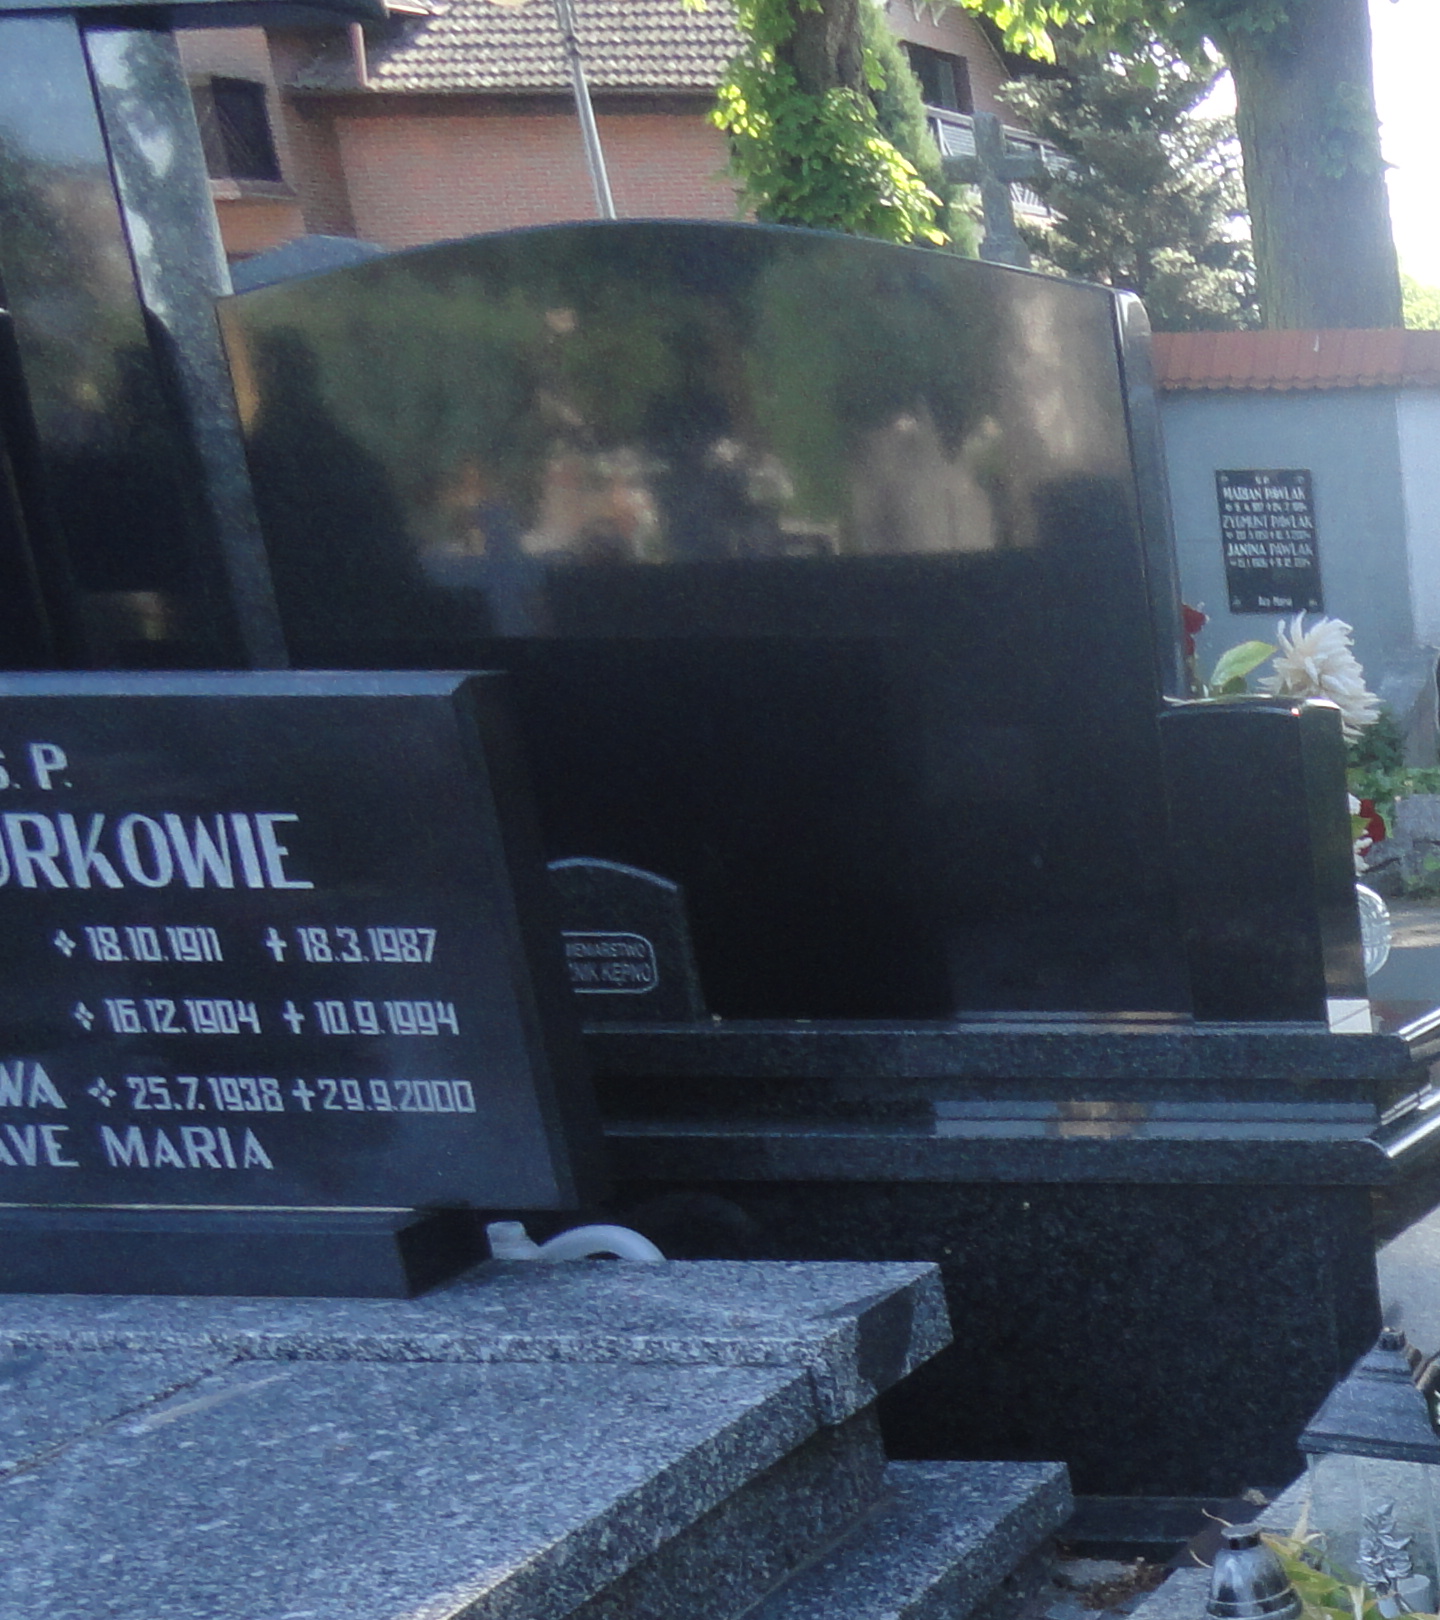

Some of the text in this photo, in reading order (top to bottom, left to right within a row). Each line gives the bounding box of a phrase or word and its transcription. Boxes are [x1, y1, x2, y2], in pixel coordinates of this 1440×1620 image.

[0, 812, 315, 889] RKOWIE
[85, 926, 437, 963] 18.10.1911 18.3.1987
[105, 998, 460, 1036] 16.12.1904 10.9.1994
[101, 1125, 274, 1170] MARIA
